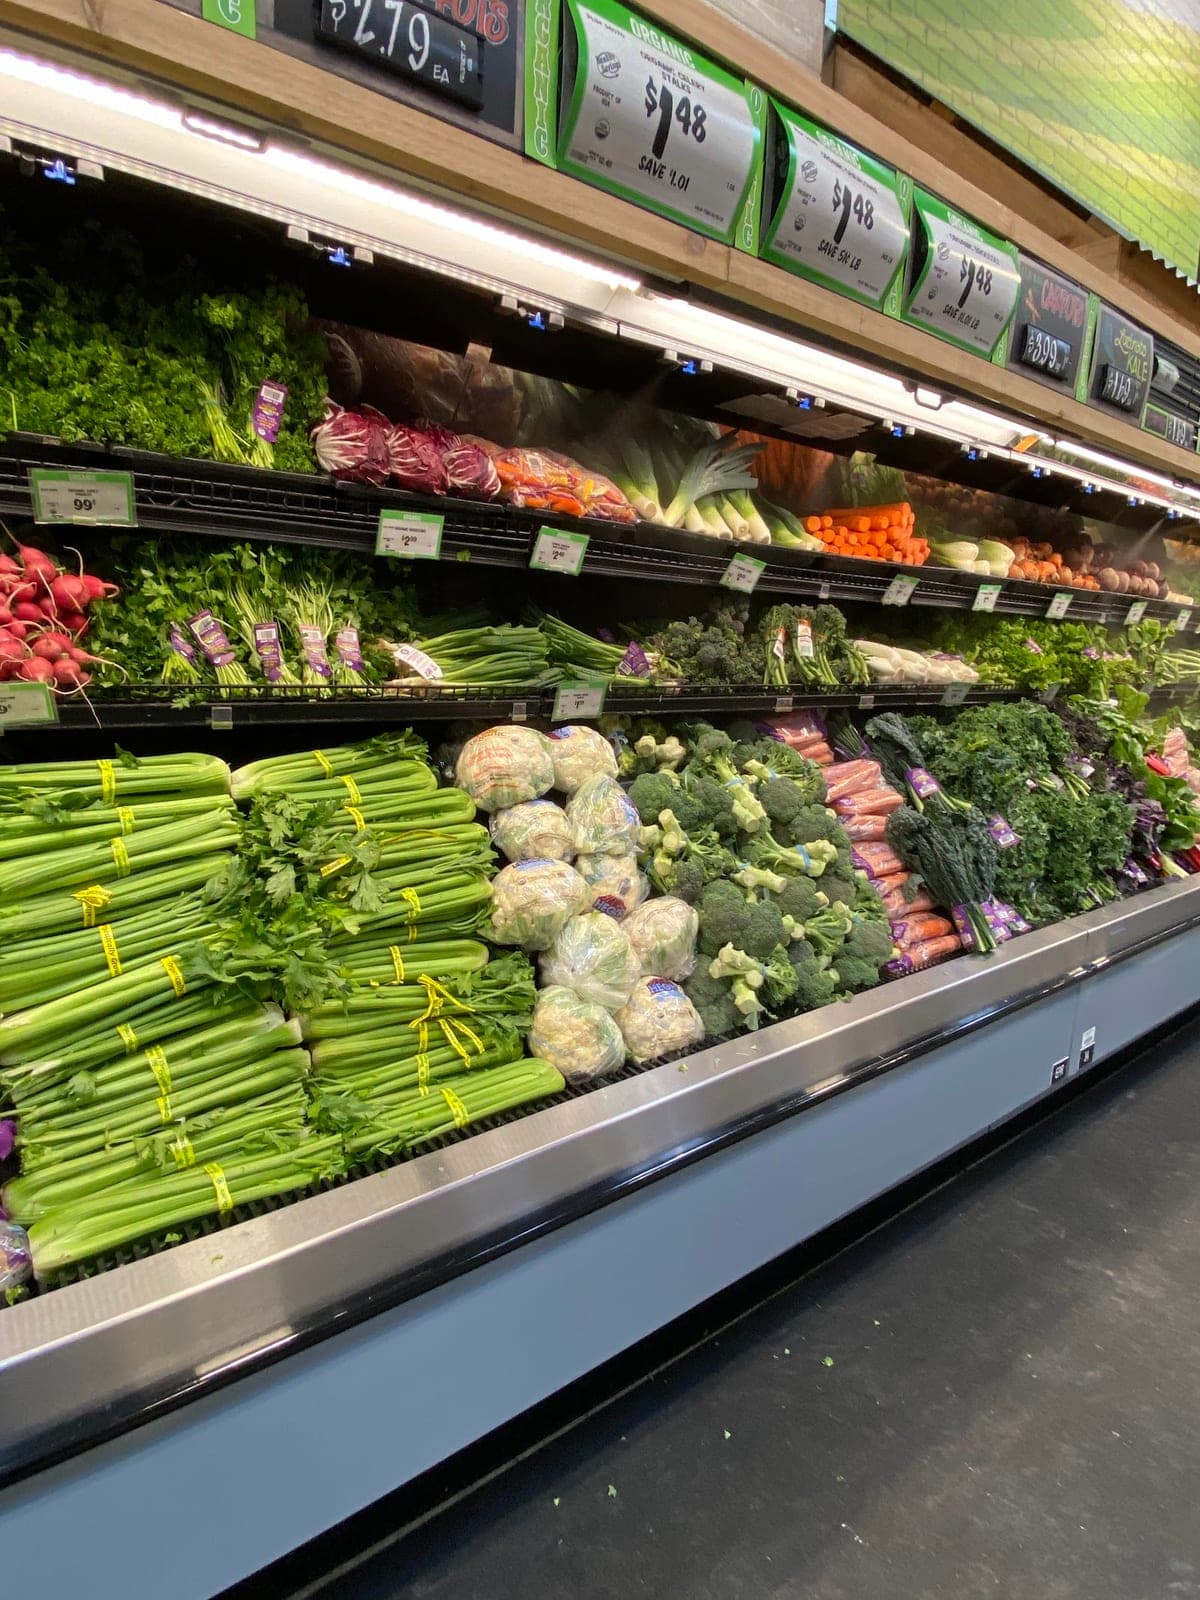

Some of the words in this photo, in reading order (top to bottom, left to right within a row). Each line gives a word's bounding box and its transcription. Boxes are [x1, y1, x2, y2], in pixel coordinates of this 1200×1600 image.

[629, 17, 697, 70] ORGANIC
[433, 64, 450, 85] EA
[638, 155, 667, 180] SAVE
[817, 239, 839, 259] SAVE
[942, 303, 958, 319] SAVE
